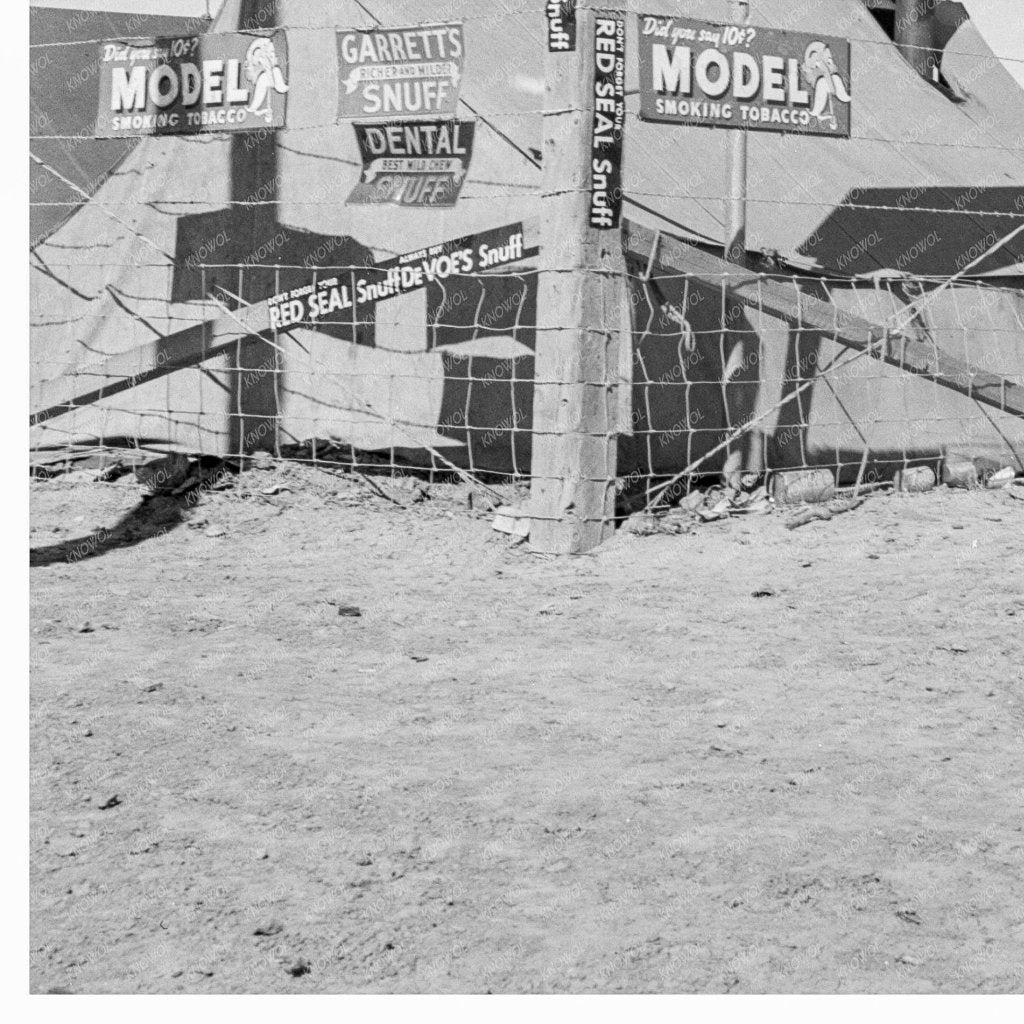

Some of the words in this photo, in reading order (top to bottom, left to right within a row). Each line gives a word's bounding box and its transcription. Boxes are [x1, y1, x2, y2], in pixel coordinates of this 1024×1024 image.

[595, 18, 617, 74] RED
[642, 17, 673, 38] Did
[671, 27, 696, 45] you
[698, 30, 721, 48] say
[102, 44, 130, 62] Did
[110, 58, 250, 114] MODEL
[652, 42, 811, 108] MODEL
[362, 81, 450, 114] SNUFF
[655, 98, 733, 120] SMOKING
[739, 104, 811, 125] TOBACCO
[111, 113, 180, 131] SMOKING
[186, 108, 248, 126] TOBACCO
[593, 81, 616, 149] SEAL
[612, 101, 624, 130] YOUR
[364, 124, 467, 155] DENTAL
[590, 158, 613, 227] Snuff
[478, 232, 523, 268] Snuff
[269, 299, 305, 330] RED
[308, 285, 353, 319] SEAL
[356, 266, 401, 304] Snuff
